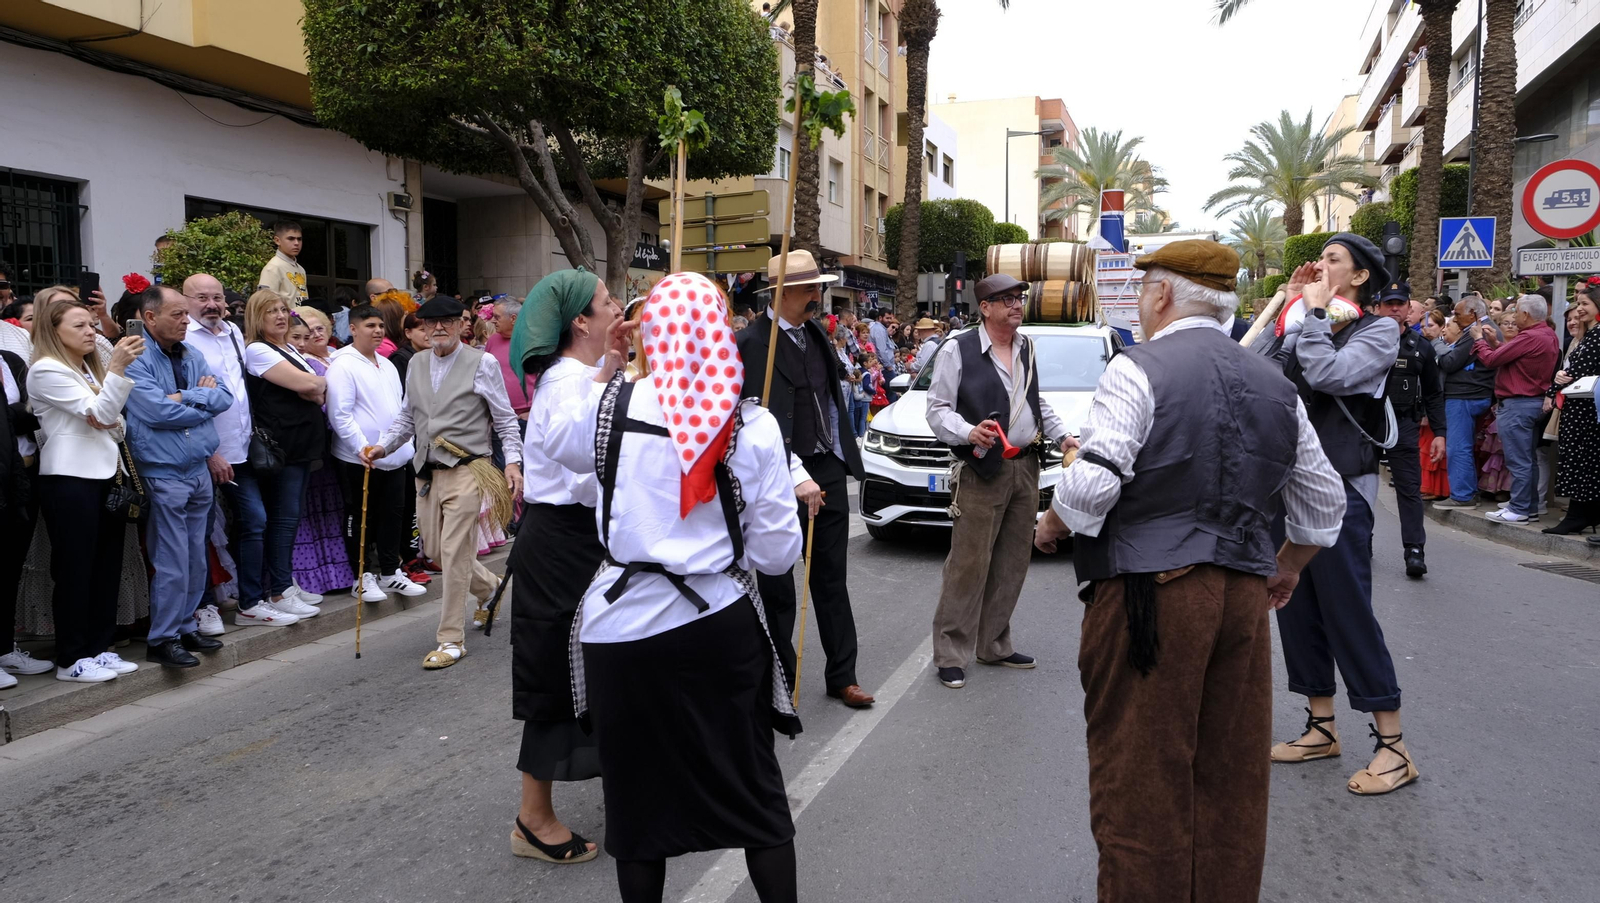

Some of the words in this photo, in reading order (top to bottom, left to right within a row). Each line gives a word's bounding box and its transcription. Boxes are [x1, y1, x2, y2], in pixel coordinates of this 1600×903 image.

[1523, 252, 1558, 261] EXCEPTO
[1560, 251, 1600, 260] VEHICULO
[1535, 262, 1592, 271] AUTORIZADOS
